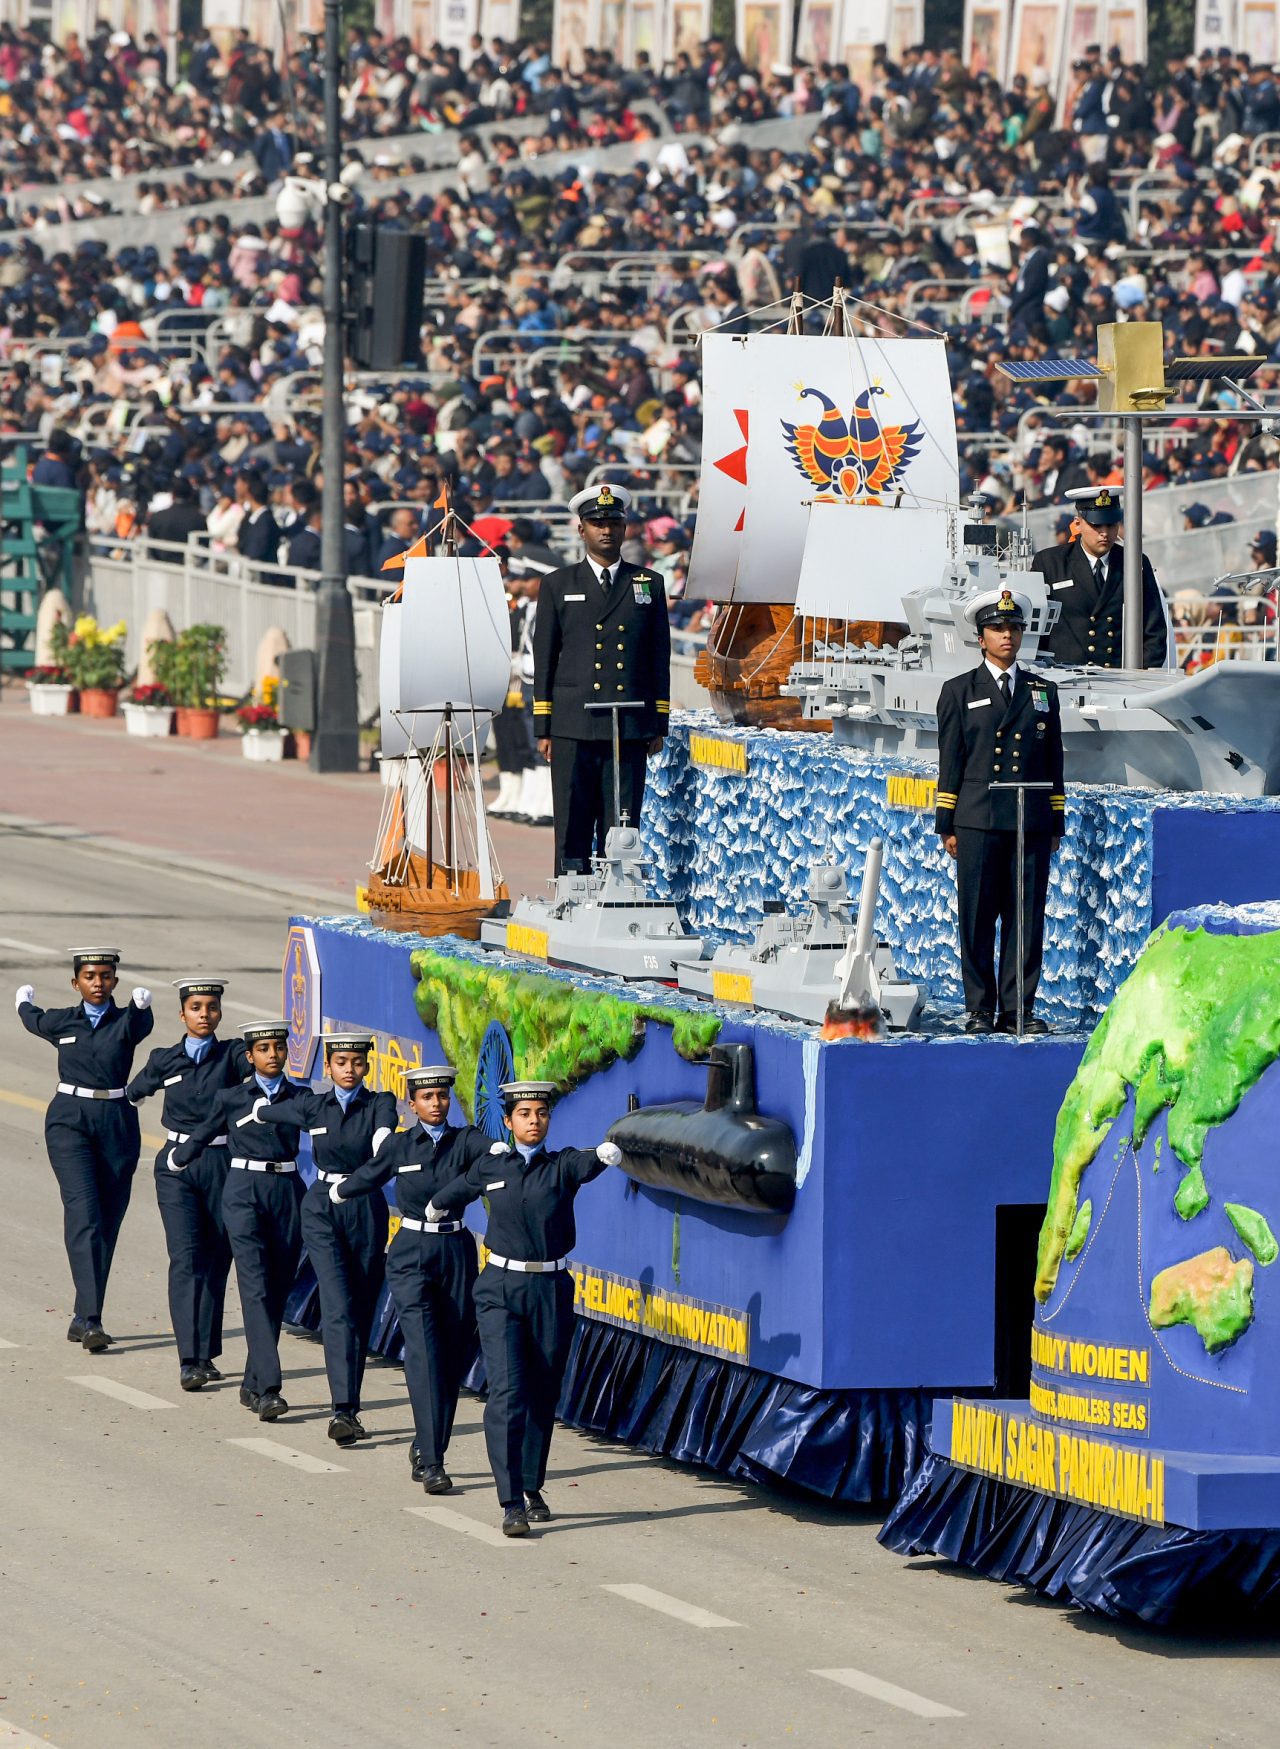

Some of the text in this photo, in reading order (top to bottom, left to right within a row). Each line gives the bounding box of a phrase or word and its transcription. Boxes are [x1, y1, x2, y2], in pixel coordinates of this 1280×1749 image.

[887, 775, 938, 808] VIKRANT
[667, 1302, 748, 1355] INNOVATION
[1038, 1333, 1067, 1371] NAVY
[1069, 1342, 1147, 1382] WOMEN
[1057, 1393, 1111, 1426] BOUNDLESS
[1112, 1402, 1147, 1430] SEAS
[951, 1402, 1164, 1522] NAVIKA SAGAR PARIKRAMA-II
